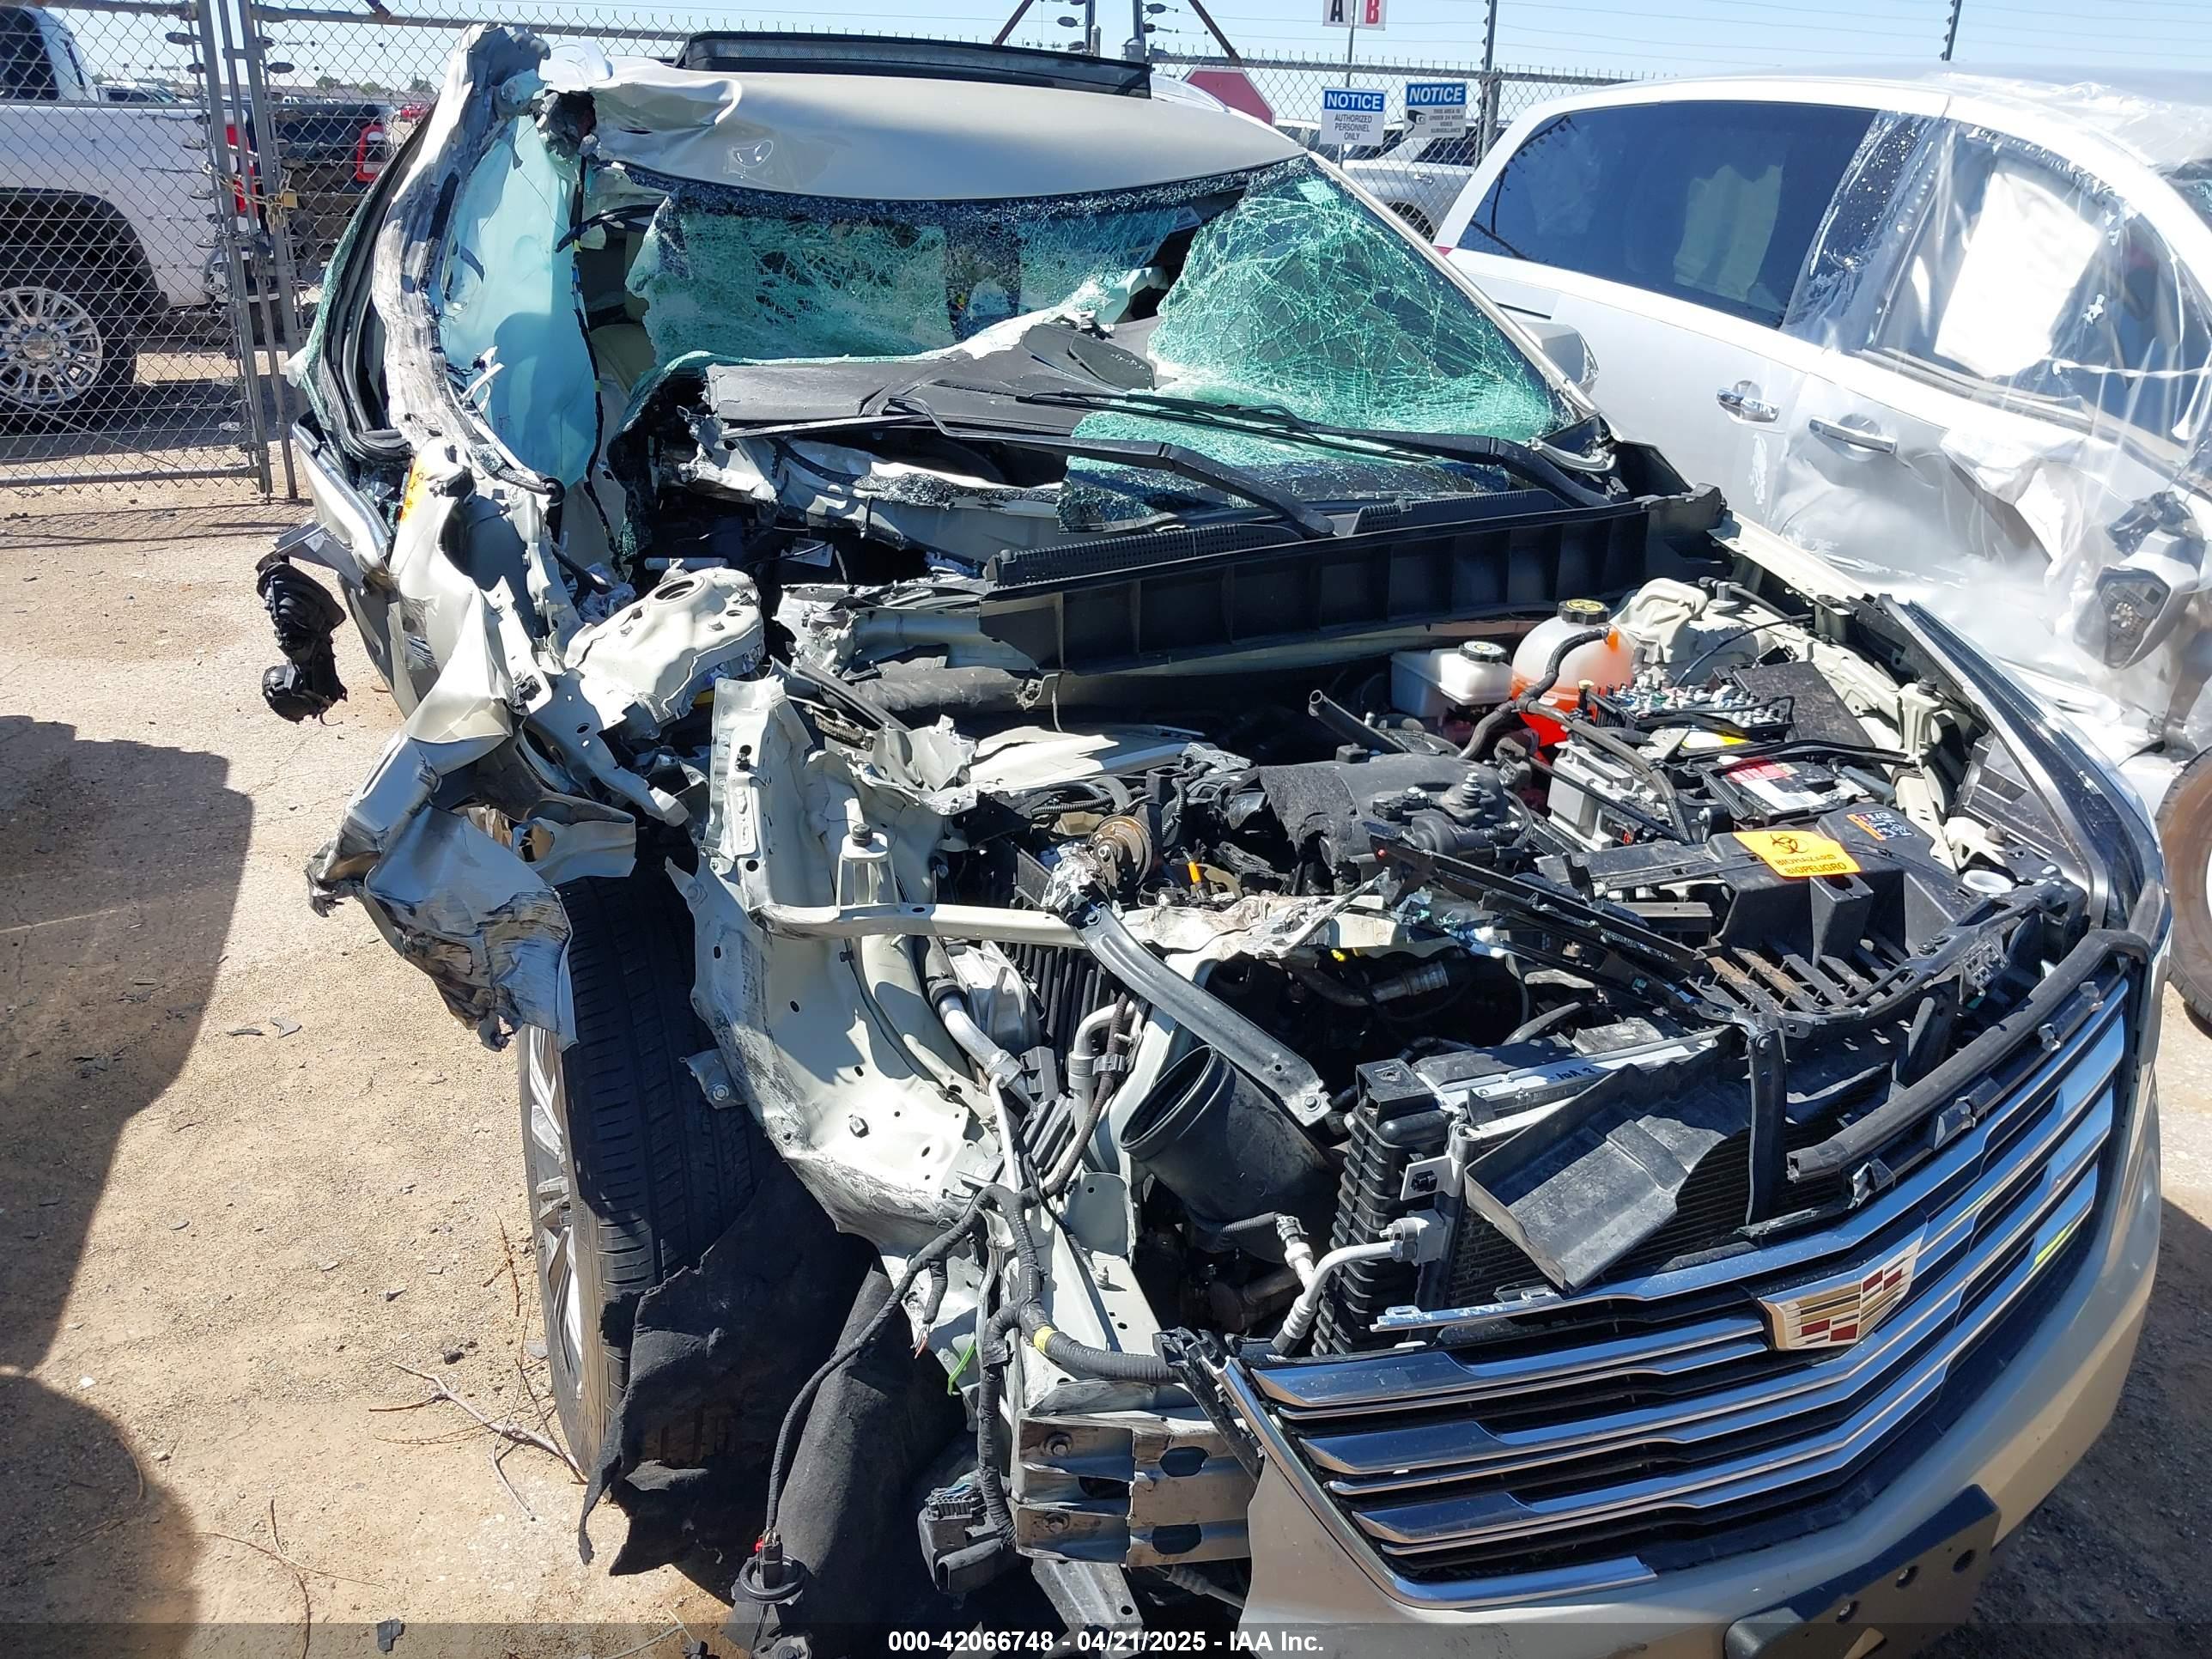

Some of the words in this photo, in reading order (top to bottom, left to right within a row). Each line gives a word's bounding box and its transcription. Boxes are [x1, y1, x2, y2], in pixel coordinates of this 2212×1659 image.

[1330, 0, 1344, 22] A
[1365, 0, 1379, 24] B
[1409, 87, 1464, 103] NOTICE
[1327, 93, 1382, 110] NOTICE
[1334, 113, 1373, 124] AUTHORIZED
[1334, 123, 1370, 132] PERSONNEL
[1344, 132, 1361, 141] ONLY
[1775, 854, 1837, 866] BIOHAZARD
[1784, 862, 1847, 873] BIOPELIGRO
